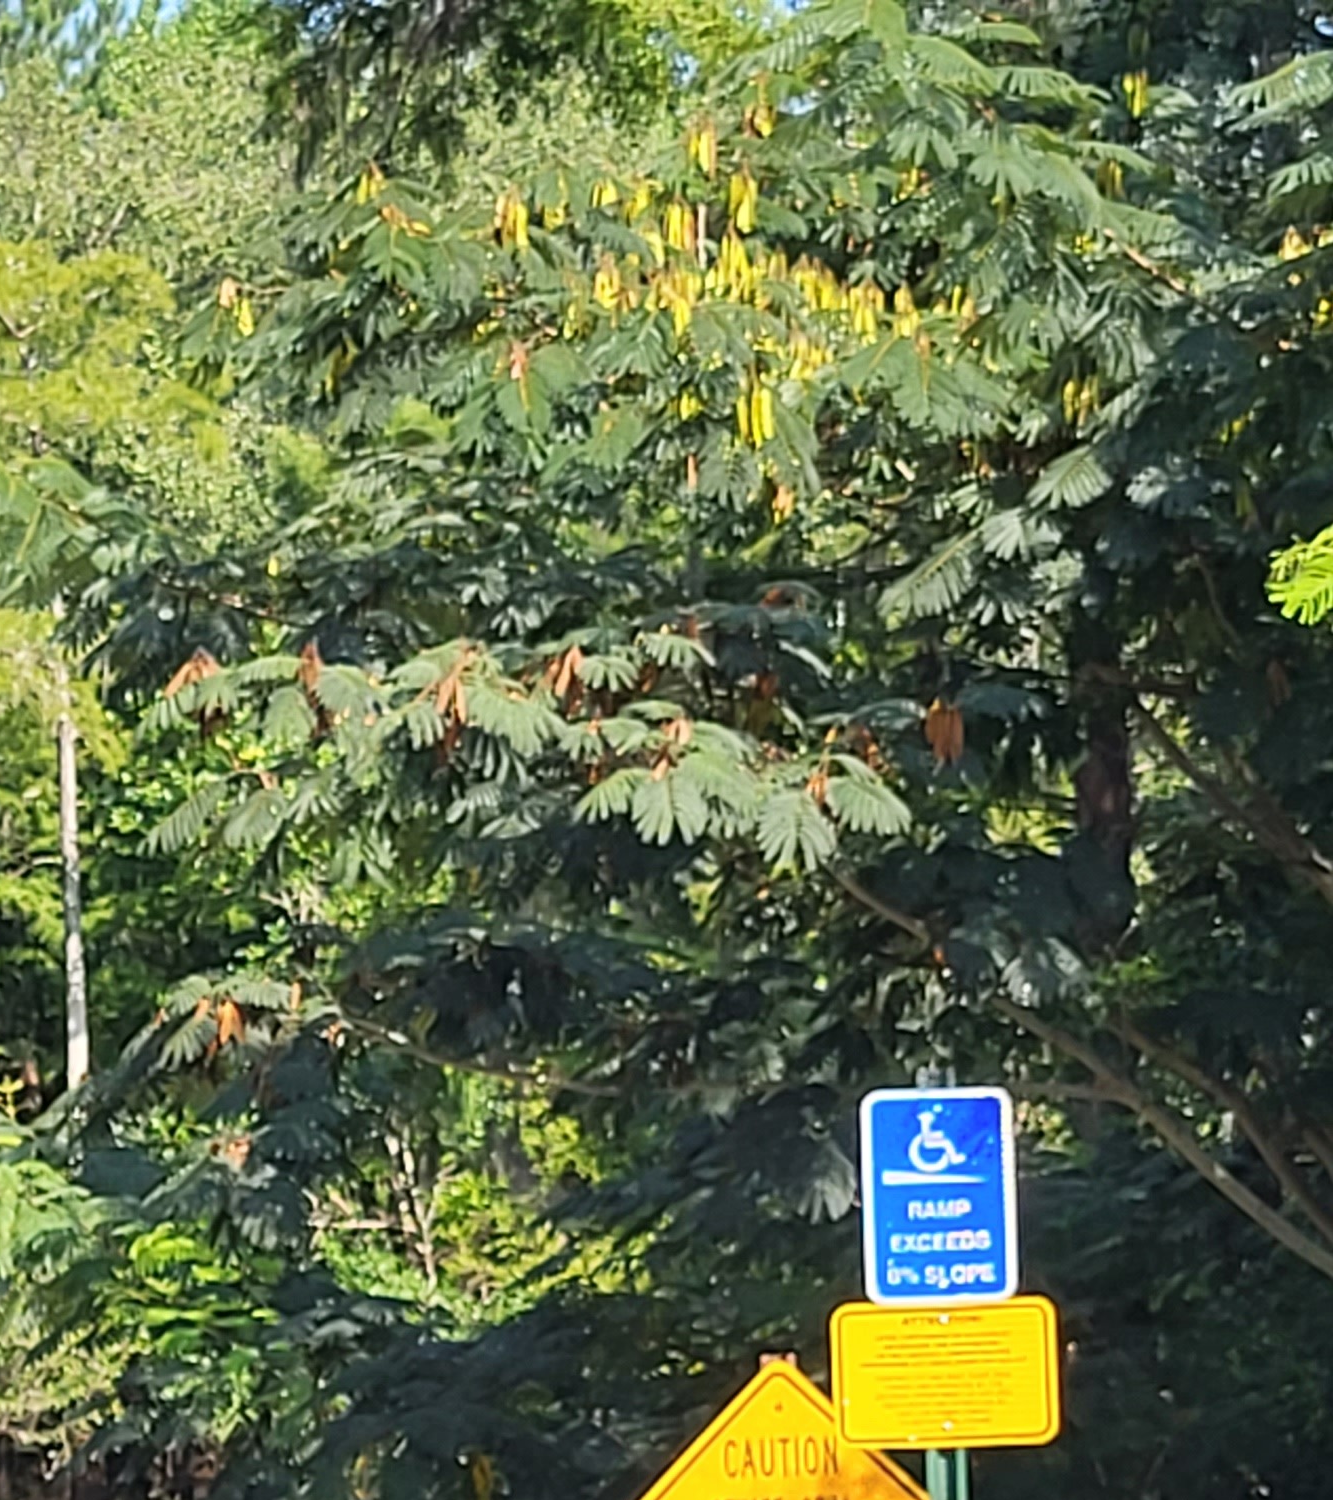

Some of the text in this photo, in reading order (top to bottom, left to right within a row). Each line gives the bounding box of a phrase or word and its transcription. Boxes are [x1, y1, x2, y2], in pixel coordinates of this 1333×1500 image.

[908, 1198, 972, 1220] RAMP
[890, 1229, 992, 1254] EXCEEDS
[924, 1262, 997, 1286] SLOPE
[724, 1436, 839, 1477] CAUTION
